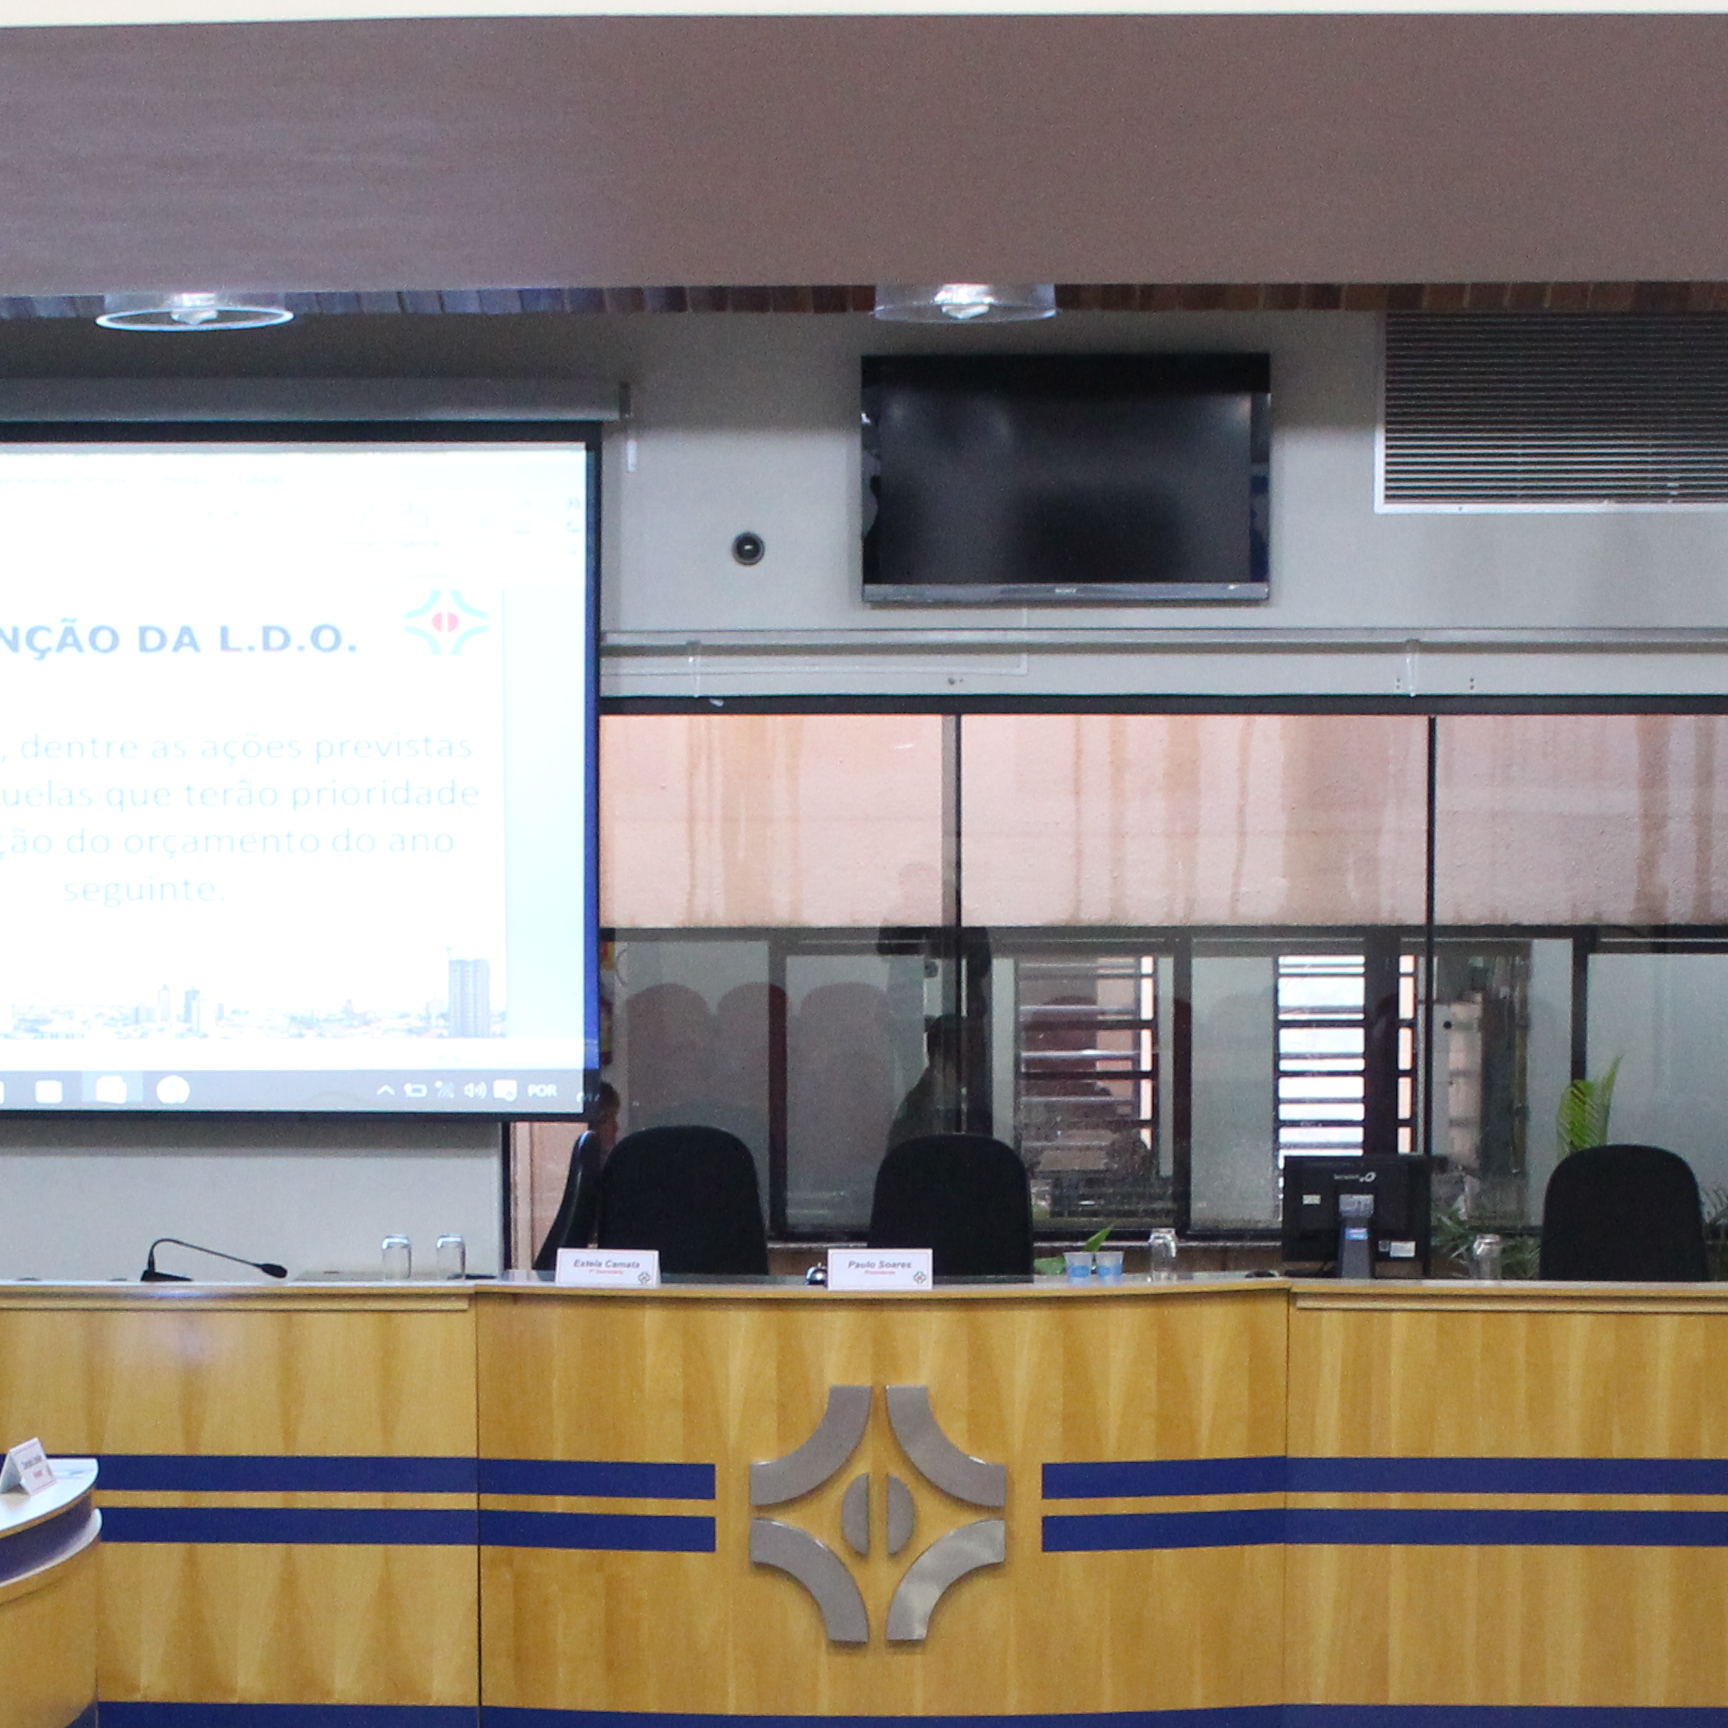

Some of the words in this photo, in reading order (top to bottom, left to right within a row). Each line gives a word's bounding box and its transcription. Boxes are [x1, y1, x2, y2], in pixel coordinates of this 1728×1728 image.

[138, 624, 201, 654] DA
[219, 623, 357, 654] L.D.O.
[20, 733, 139, 759] dentre
[151, 740, 188, 759] as
[200, 732, 303, 766] ações
[315, 735, 473, 765] previstas
[105, 787, 172, 813] que
[184, 778, 279, 807] terão
[292, 778, 480, 812] prioridade
[66, 827, 111, 854] do
[123, 831, 321, 860] orçamento
[331, 827, 377, 853] do
[389, 833, 455, 853] ano
[64, 879, 225, 908] seguinte.
[527, 1083, 558, 1098] POR
[847, 1260, 876, 1269] Paulo
[878, 1260, 912, 1269] Soares
